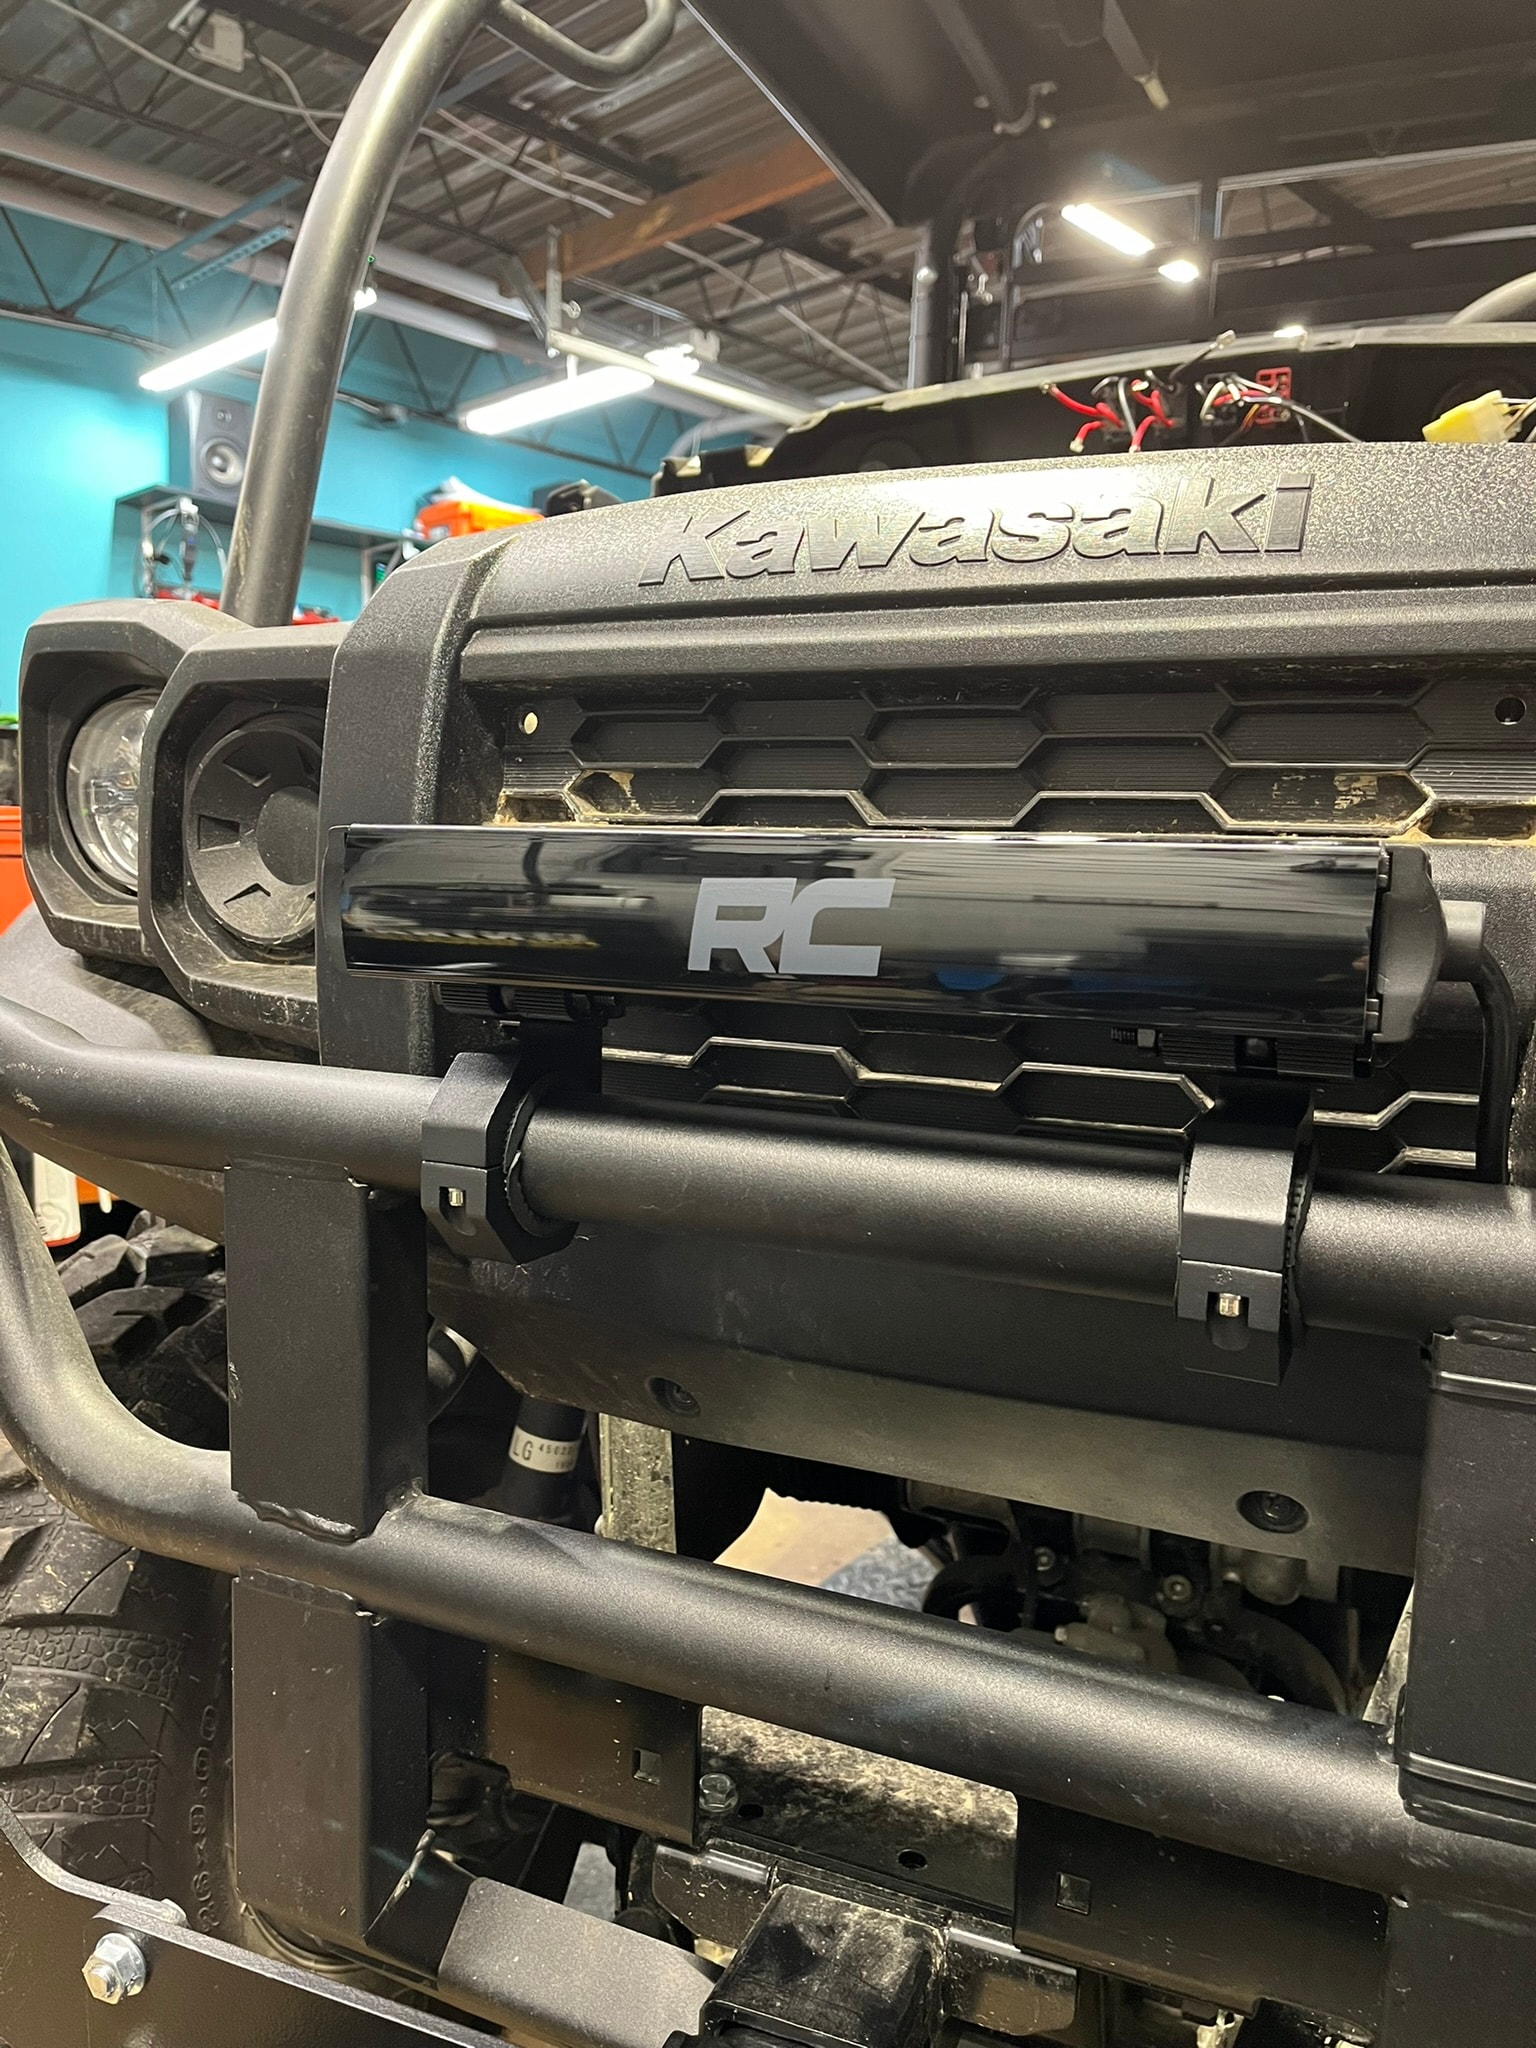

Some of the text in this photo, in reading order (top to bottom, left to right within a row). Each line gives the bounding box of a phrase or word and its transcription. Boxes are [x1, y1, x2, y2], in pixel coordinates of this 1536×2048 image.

[638, 472, 1315, 586] Kawasaki
[687, 877, 896, 977] RC
[512, 1433, 534, 1461] LG
